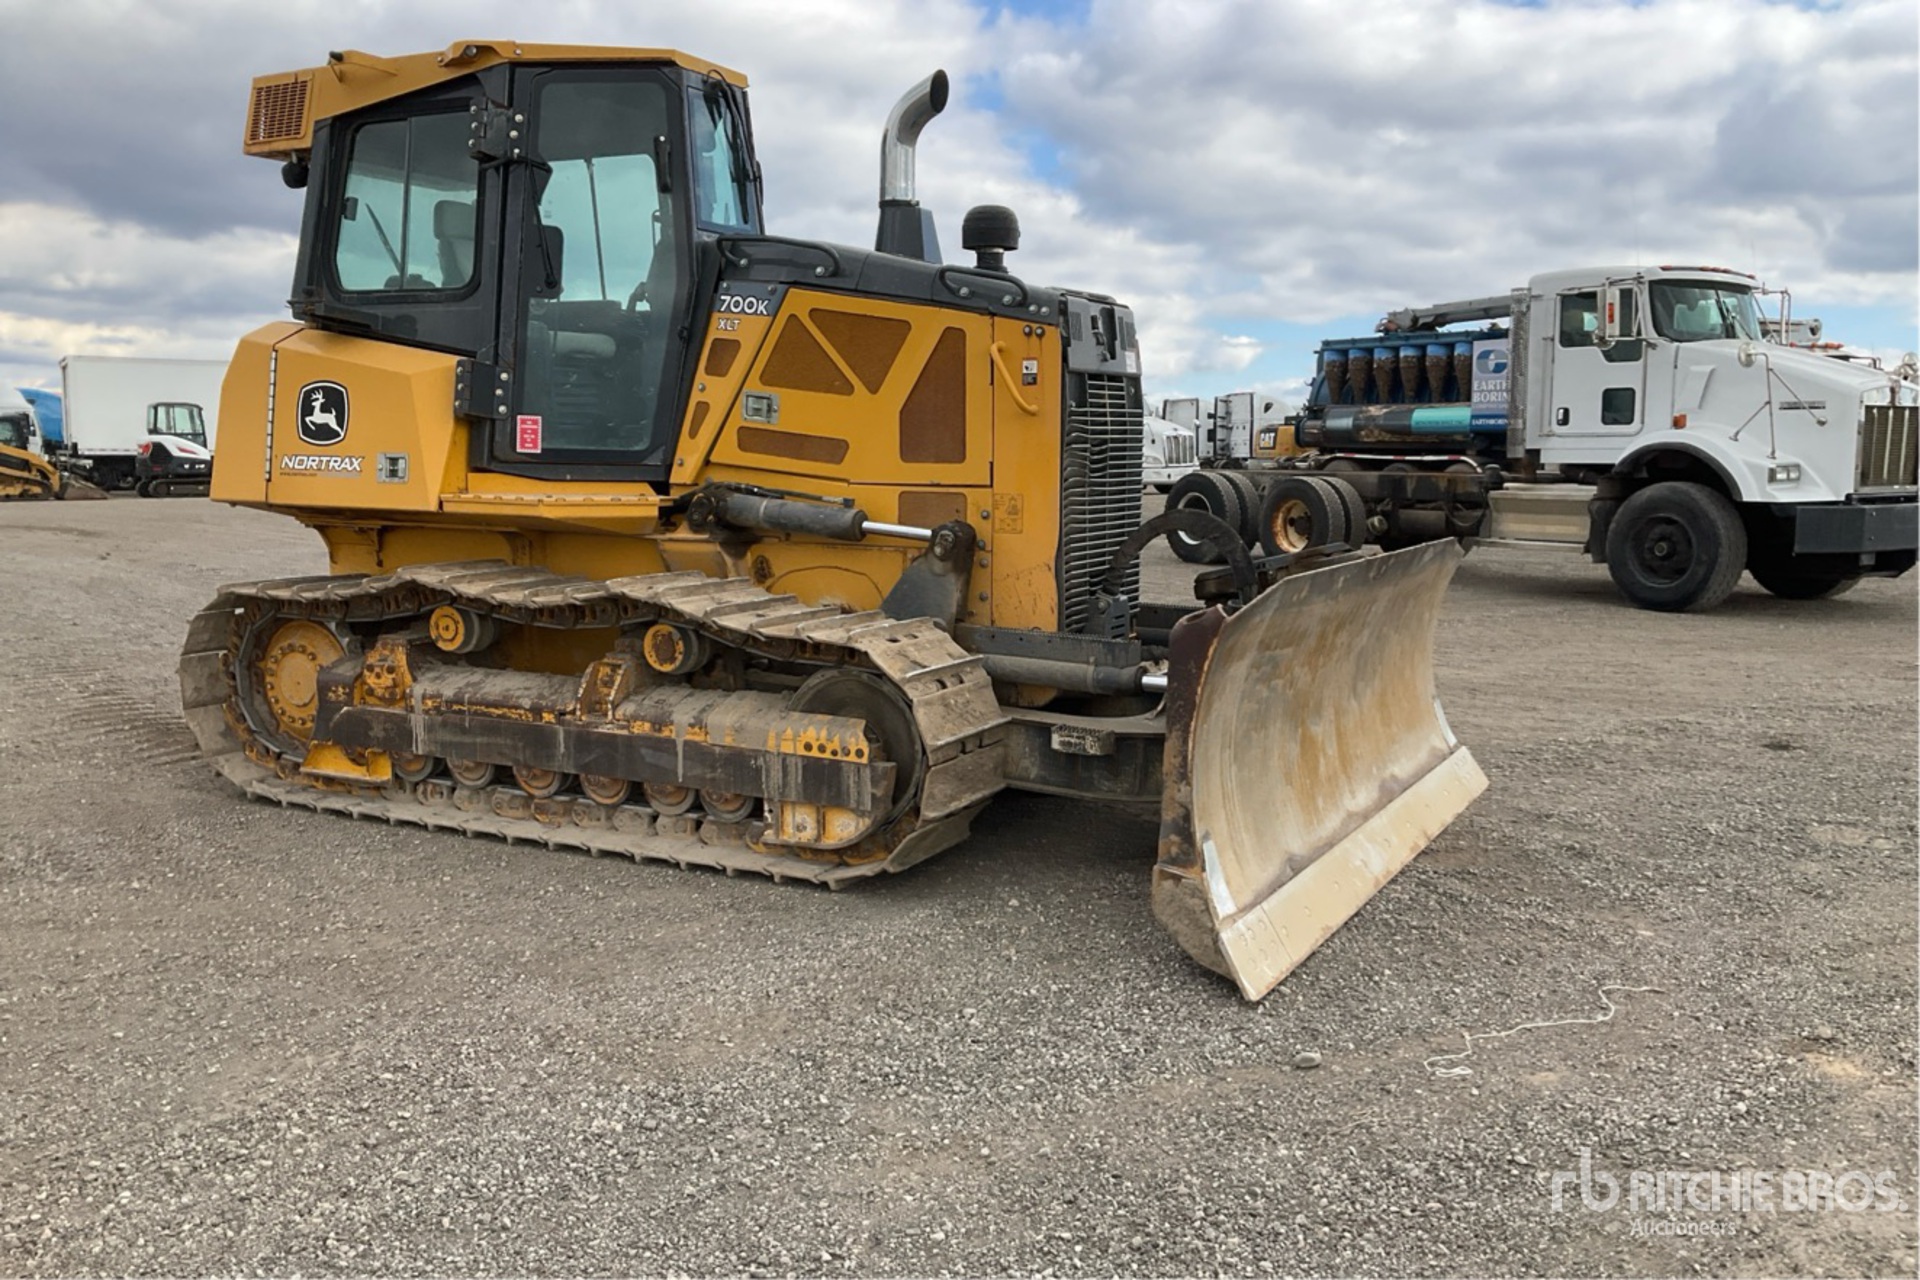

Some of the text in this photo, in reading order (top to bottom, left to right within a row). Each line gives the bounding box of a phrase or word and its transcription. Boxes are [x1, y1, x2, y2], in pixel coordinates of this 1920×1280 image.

[720, 295, 769, 315] 700K
[717, 319, 740, 331] XLT
[1260, 432, 1275, 447] CAT
[281, 455, 363, 472] NORTRAX
